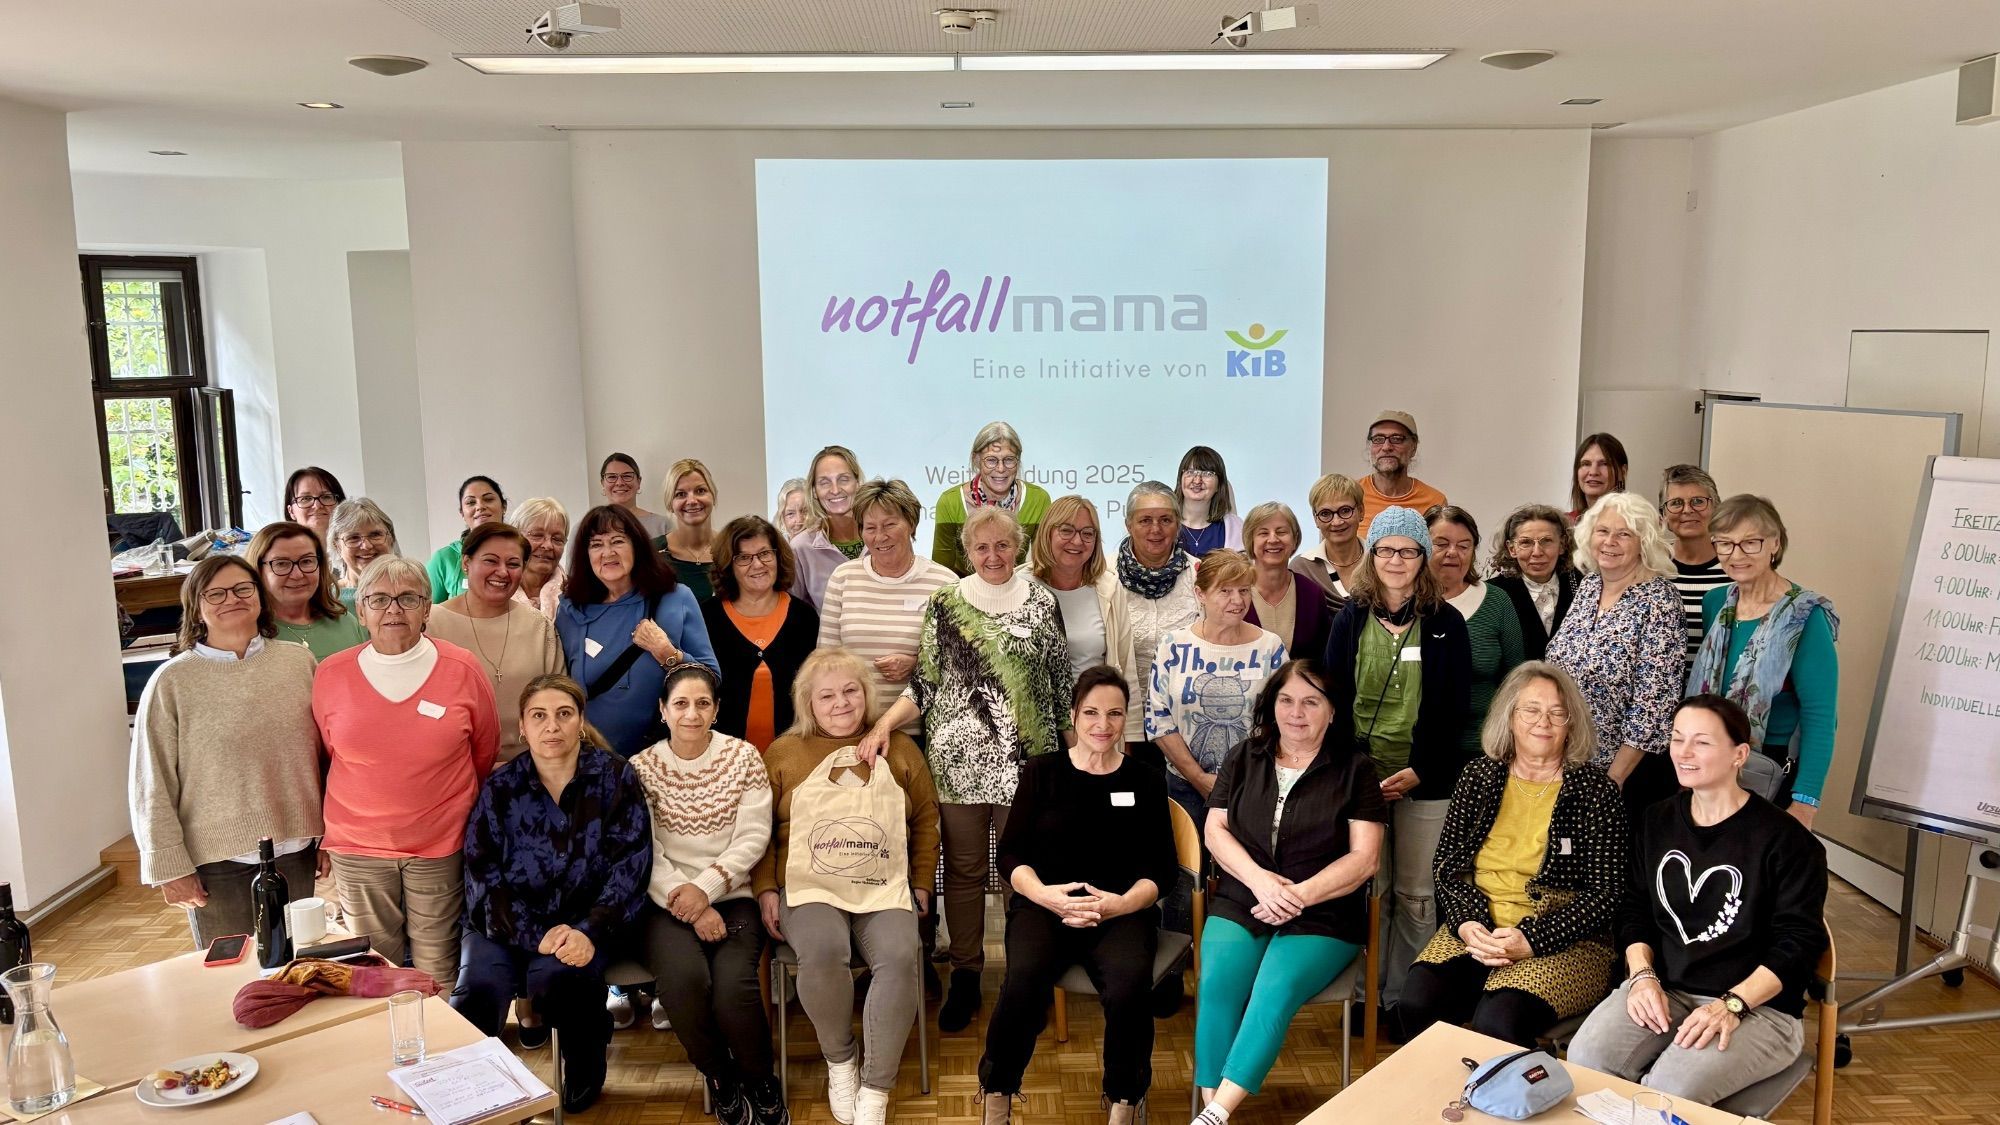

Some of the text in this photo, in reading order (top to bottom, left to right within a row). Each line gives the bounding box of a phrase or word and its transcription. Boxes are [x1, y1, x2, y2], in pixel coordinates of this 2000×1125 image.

[821, 268, 1208, 365] notfallmama
[973, 358, 1207, 379] Eine Initiative von
[1226, 349, 1287, 378] KiB
[1085, 464, 1146, 484] 2025
